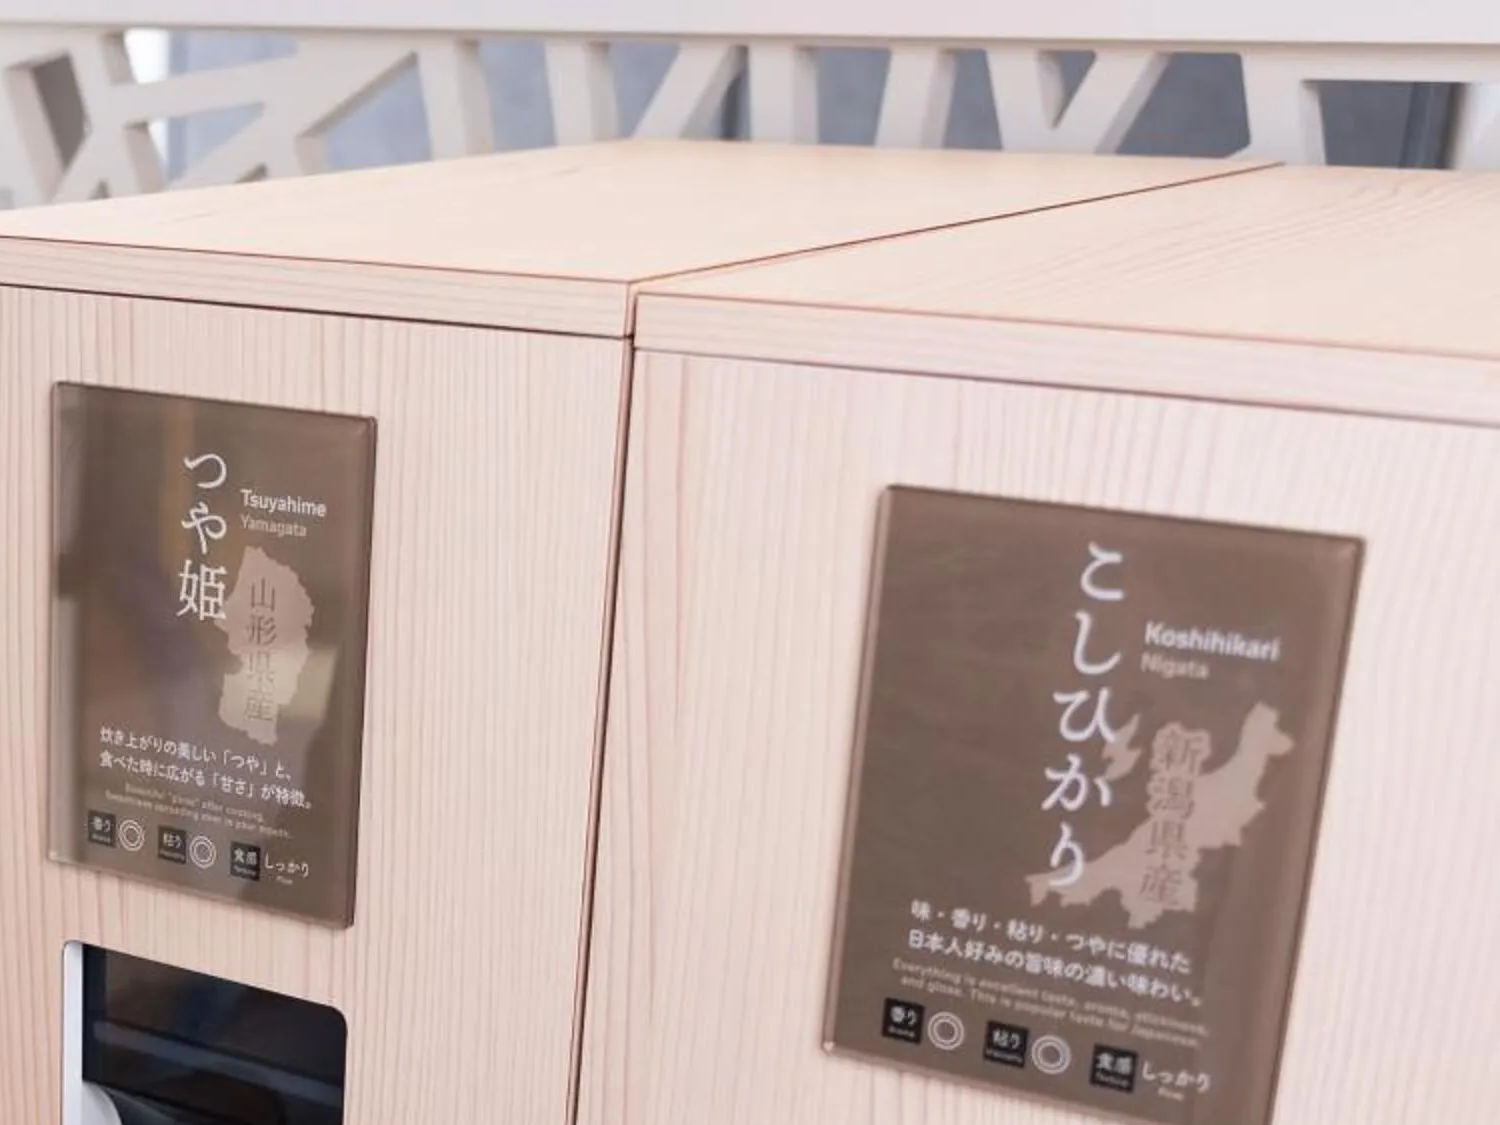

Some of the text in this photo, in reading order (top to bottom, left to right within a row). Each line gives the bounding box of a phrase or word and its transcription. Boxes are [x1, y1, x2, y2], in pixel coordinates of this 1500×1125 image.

[177, 452, 227, 622] つや姫
[240, 488, 327, 518] Tsuyahime
[240, 515, 307, 538] Yamagata
[244, 577, 278, 723] 山形県産
[1144, 621, 1281, 662] Koshihikari
[1041, 542, 1123, 889] こしひかり
